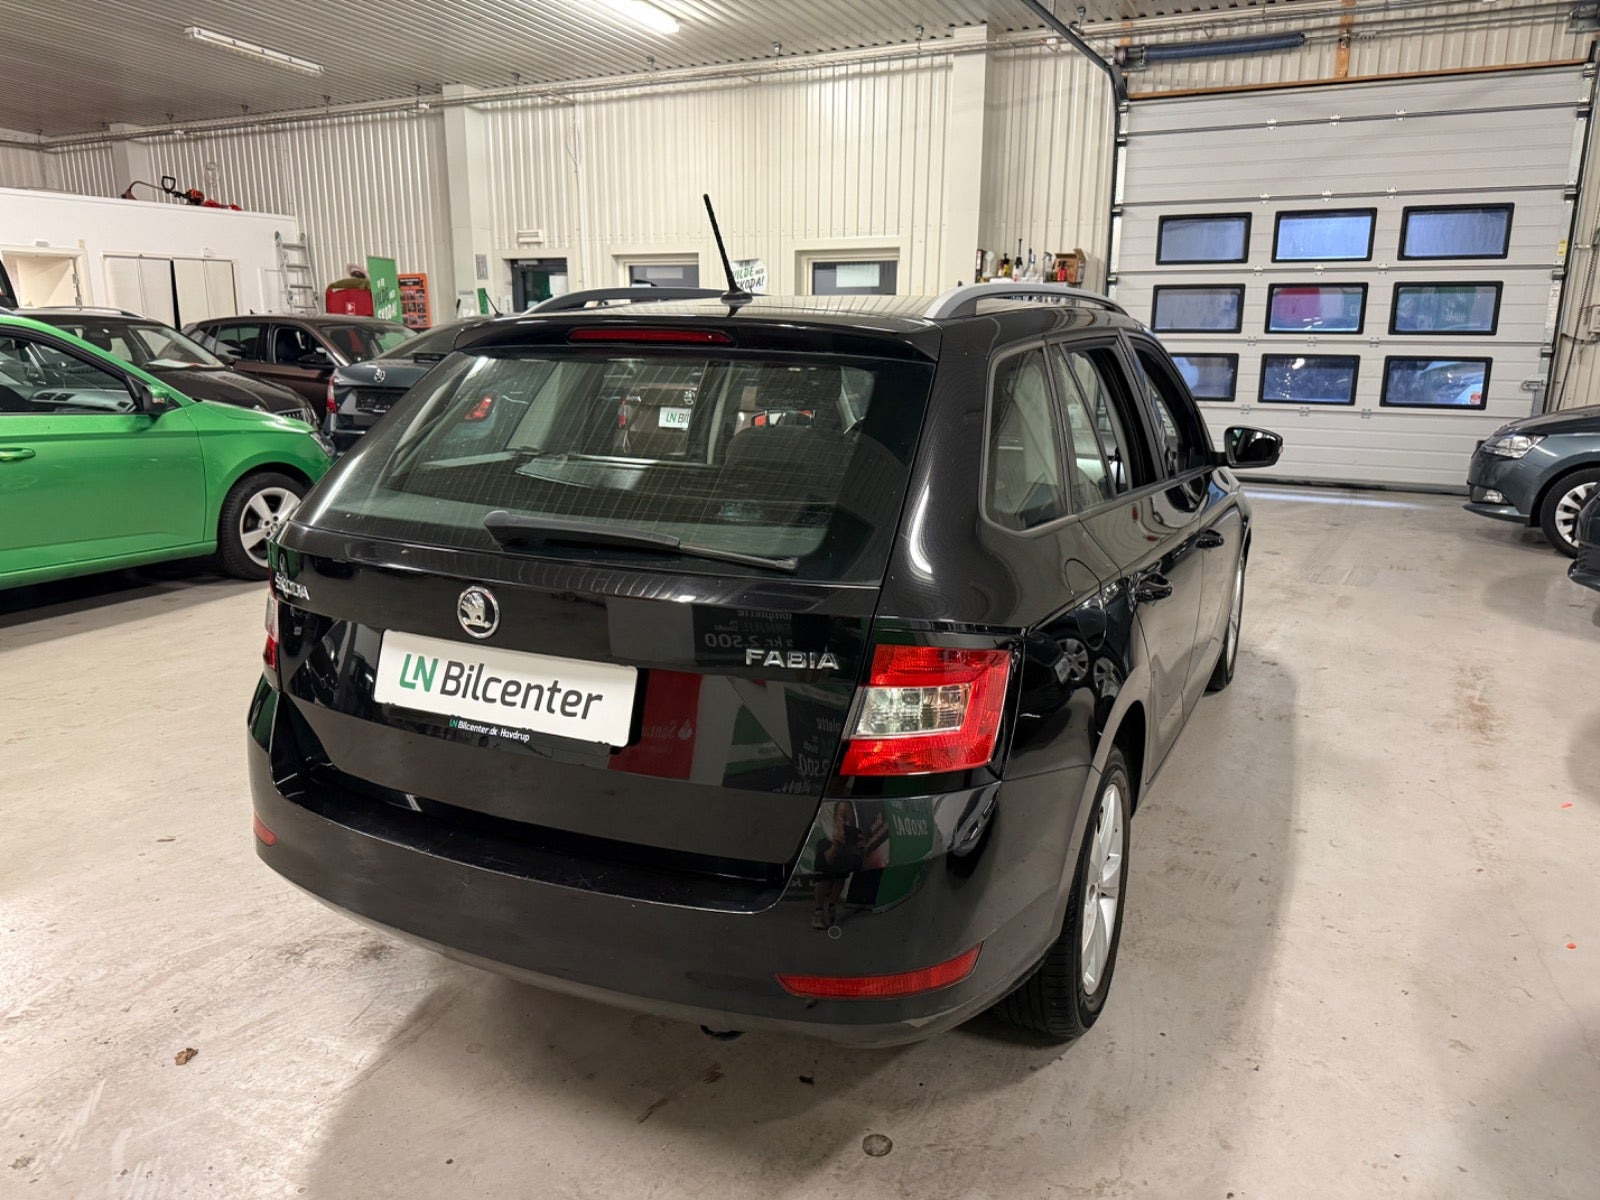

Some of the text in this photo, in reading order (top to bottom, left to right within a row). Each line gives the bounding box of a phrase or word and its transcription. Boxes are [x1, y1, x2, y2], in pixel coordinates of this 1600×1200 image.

[745, 648, 840, 671] FABIA
[399, 653, 604, 720] LN Bilcenter
